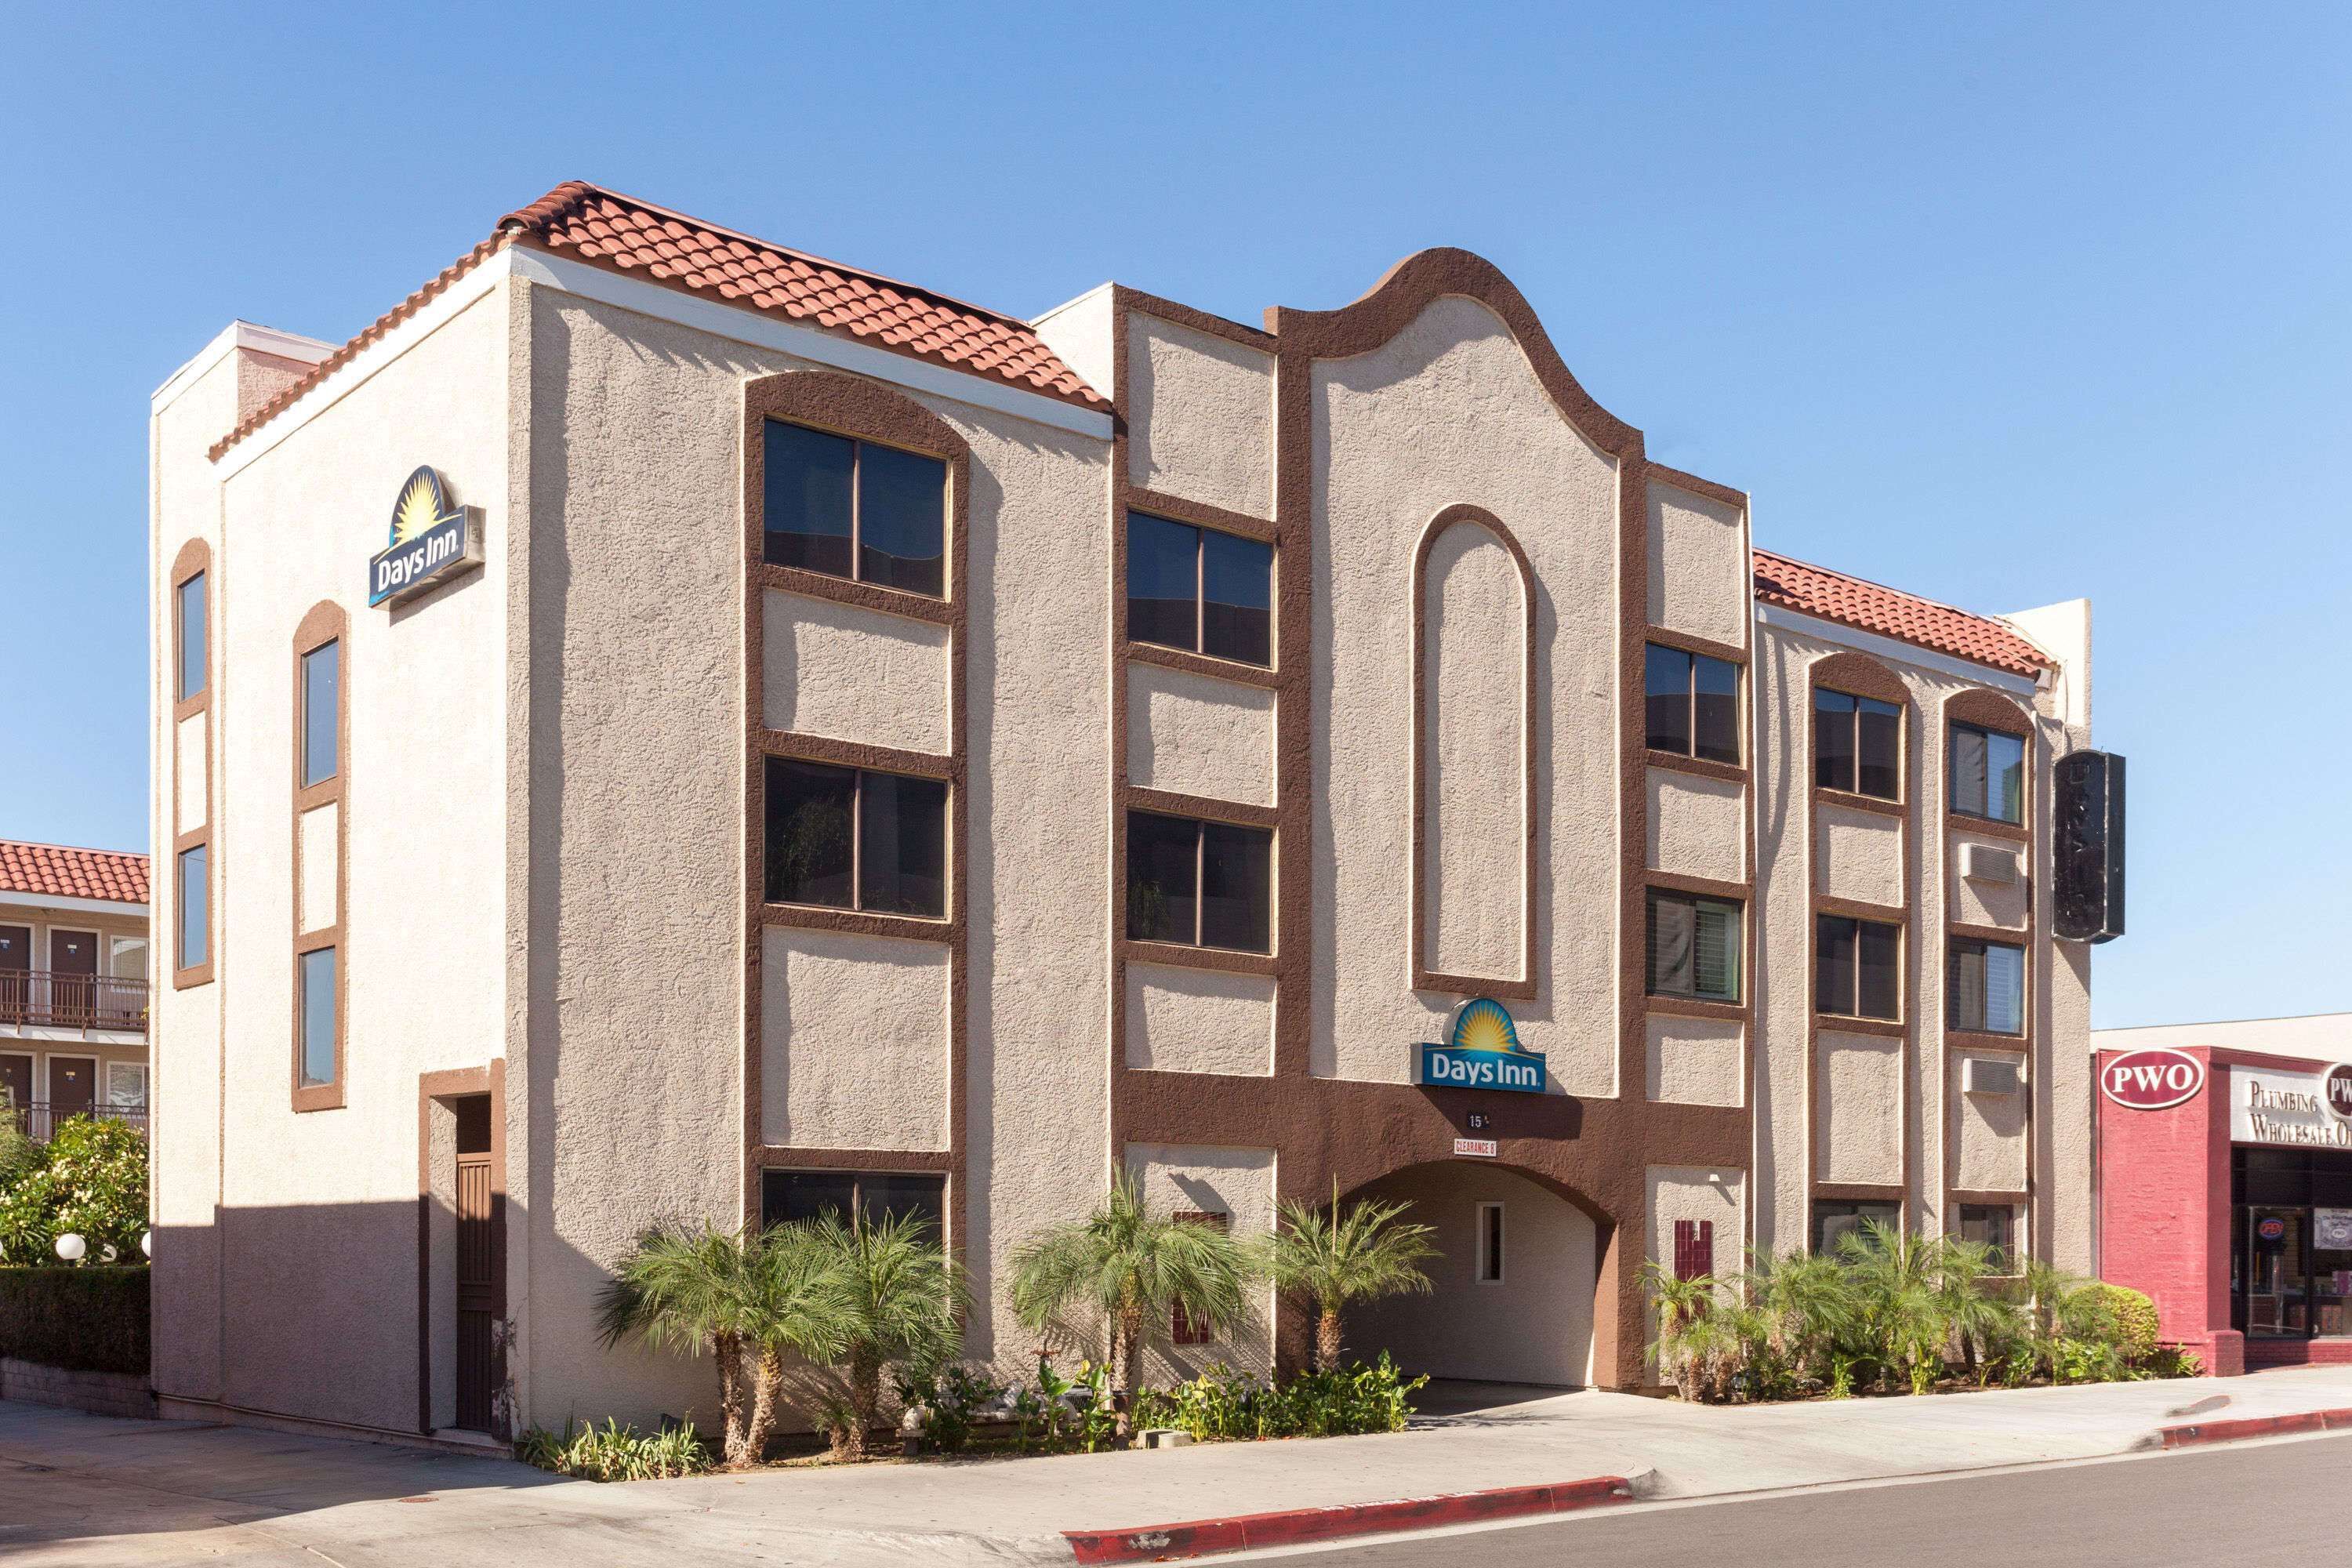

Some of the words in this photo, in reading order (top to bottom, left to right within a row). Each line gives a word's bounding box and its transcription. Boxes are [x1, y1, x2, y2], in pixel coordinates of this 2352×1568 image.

[378, 547, 424, 592] Days
[426, 529, 457, 567] Inn
[1432, 1053, 1494, 1085] Days
[1497, 1059, 1537, 1087] Inn
[2111, 1064, 2194, 1092] PWO
[2249, 1080, 2318, 1113] PLUMBING
[2249, 1112, 2332, 1145] WHOLESALE
[2336, 1120, 2352, 1145] O
[1456, 1141, 1489, 1154] CLEARANCE
